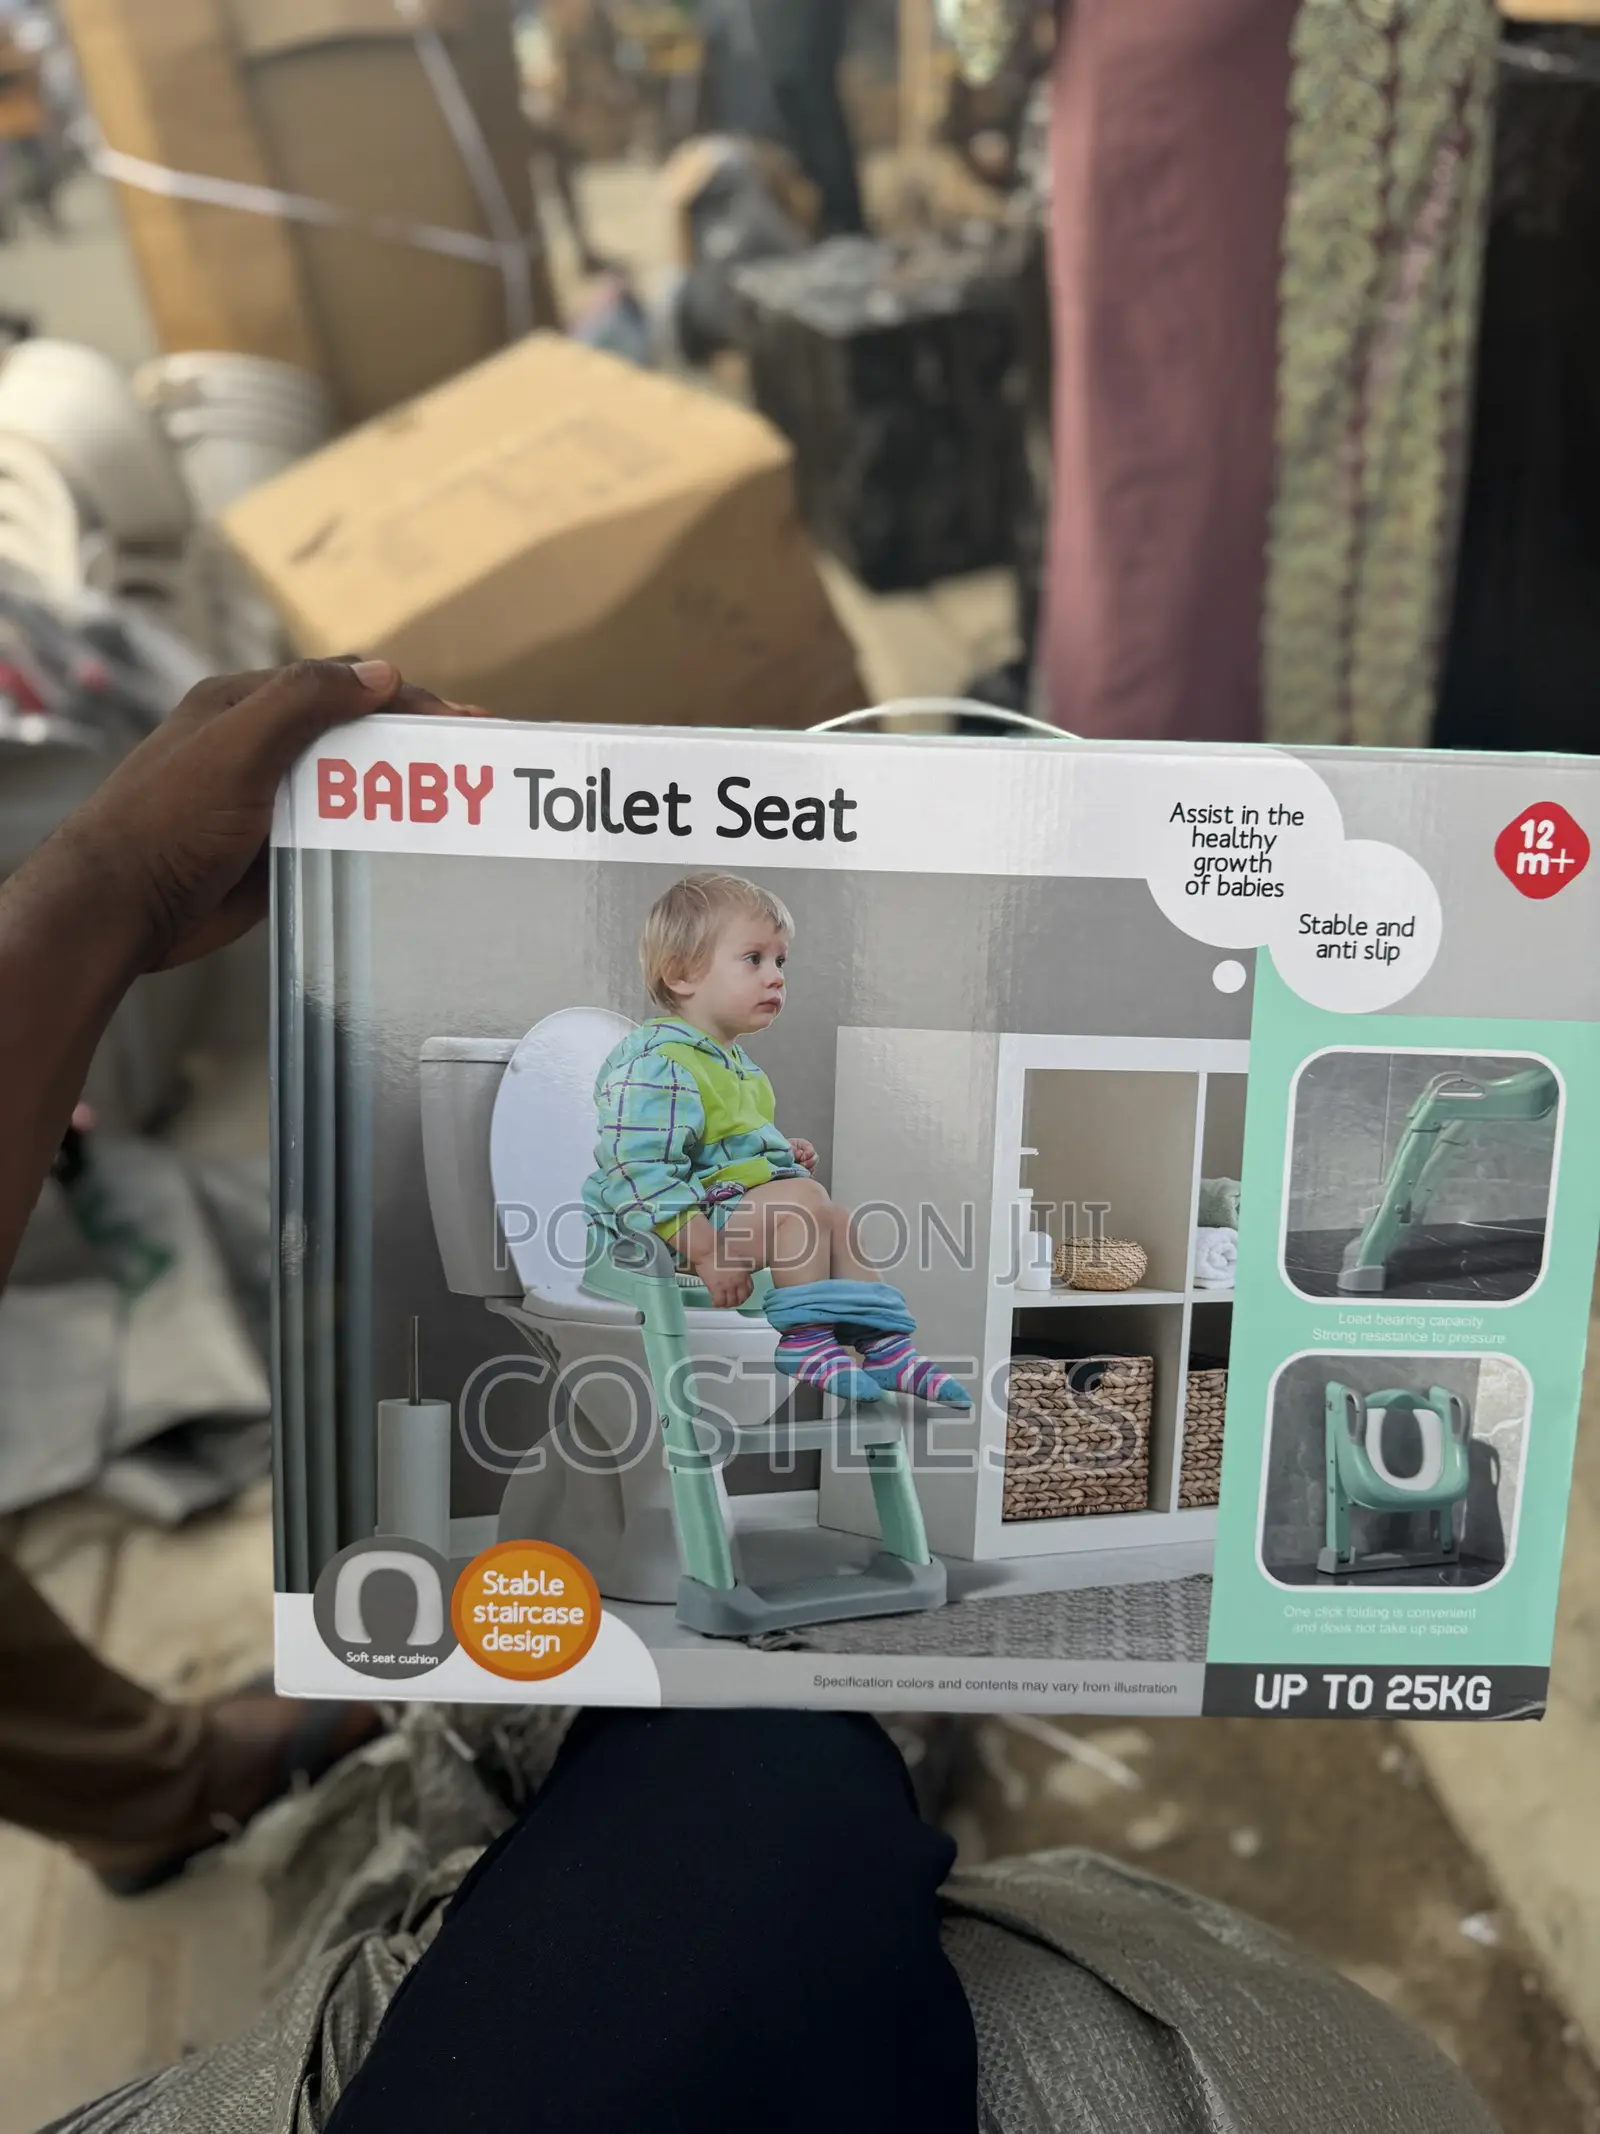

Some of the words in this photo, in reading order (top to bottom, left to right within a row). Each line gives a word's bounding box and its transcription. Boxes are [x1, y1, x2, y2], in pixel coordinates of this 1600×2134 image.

[317, 758, 493, 825] BABY
[513, 767, 692, 837] Toilet
[716, 776, 857, 843] Seat
[1169, 801, 1234, 824] Assist
[1241, 805, 1259, 825] in
[1268, 803, 1304, 826] the
[1192, 825, 1277, 854] healthy
[1520, 819, 1555, 849] 12
[1194, 851, 1272, 877] growth
[1516, 849, 1575, 876] m+
[1185, 874, 1211, 895] of
[1217, 874, 1284, 897] babies
[1299, 914, 1368, 936] Stable
[1376, 916, 1416, 937] and
[1316, 939, 1357, 960] anti
[1364, 940, 1401, 965] slip
[1338, 1312, 1371, 1325] Load
[1374, 1313, 1425, 1329] bearing
[1429, 1315, 1484, 1329] capacity
[1312, 1328, 1357, 1344] Strong
[1361, 1331, 1427, 1343] resistance
[1432, 1332, 1445, 1343] to
[1448, 1334, 1506, 1346] pressure
[482, 1569, 565, 1596] Stable
[473, 1602, 584, 1625] staircase
[1283, 1605, 1311, 1618] One
[1314, 1606, 1343, 1618] click
[1347, 1606, 1389, 1620] folding
[1393, 1608, 1403, 1619] is
[1407, 1607, 1476, 1619] convenient
[1356, 1622, 1376, 1634] not
[1379, 1622, 1406, 1634] take
[1410, 1624, 1426, 1636] up
[1429, 1624, 1468, 1636] space
[482, 1626, 561, 1658] design
[346, 1651, 369, 1664] Soft
[372, 1653, 396, 1664] seat
[398, 1653, 439, 1665] cushion
[813, 1675, 893, 1691] Specification
[896, 1678, 934, 1690] colors
[938, 1679, 962, 1690] and
[965, 1680, 1018, 1692] contents
[1022, 1681, 1048, 1693] may
[1052, 1681, 1079, 1694] vary
[1082, 1682, 1110, 1693] from
[1114, 1682, 1178, 1694] illustration
[1254, 1673, 1308, 1710] UP
[1322, 1674, 1373, 1710] TO
[1385, 1675, 1492, 1711] 25KG
